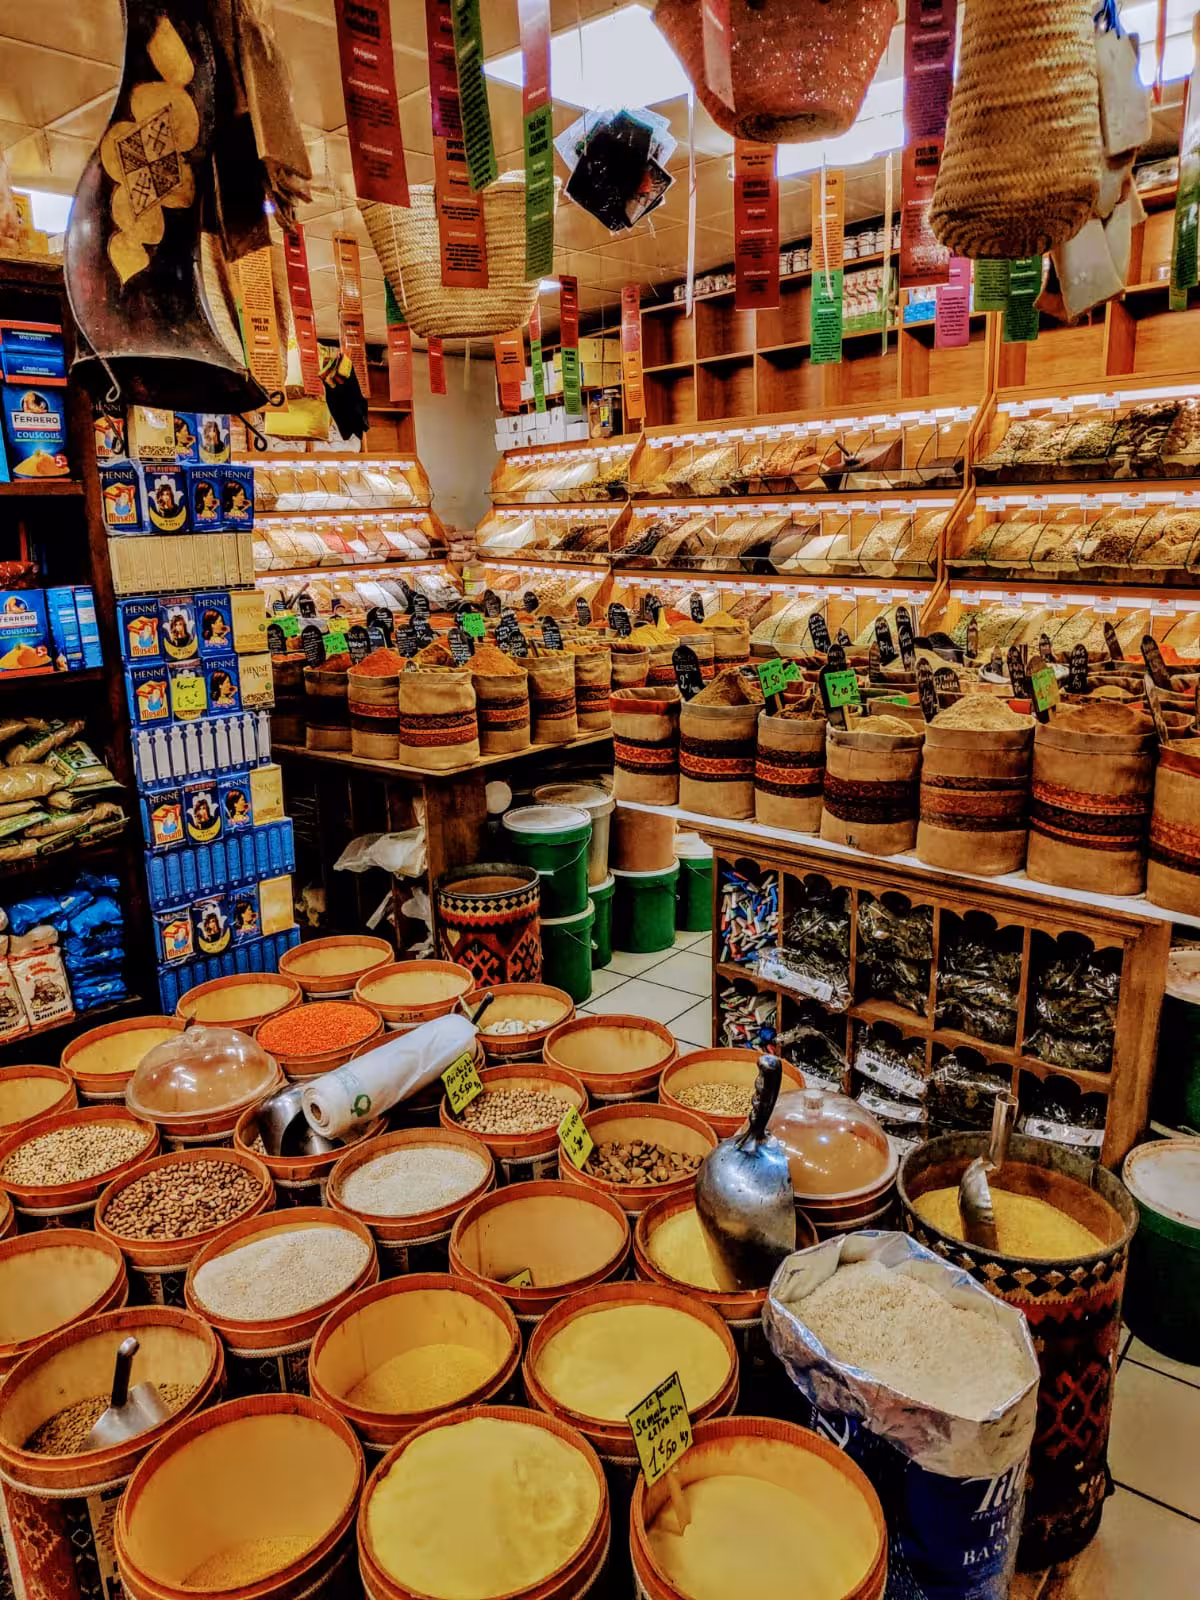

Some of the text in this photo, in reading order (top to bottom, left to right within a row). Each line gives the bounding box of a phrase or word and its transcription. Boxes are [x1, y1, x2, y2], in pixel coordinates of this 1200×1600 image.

[14, 414, 58, 424] FERRERO
[16, 431, 60, 439] COUSCOUS
[101, 470, 134, 480] HENNÉ
[191, 470, 218, 479] HENNÉ
[221, 469, 251, 479] HENNÉ
[198, 598, 229, 607] HENNÉ
[125, 604, 157, 614] HENNÉ
[206, 658, 236, 669] HENNÉ
[134, 668, 165, 679] HENNÉ
